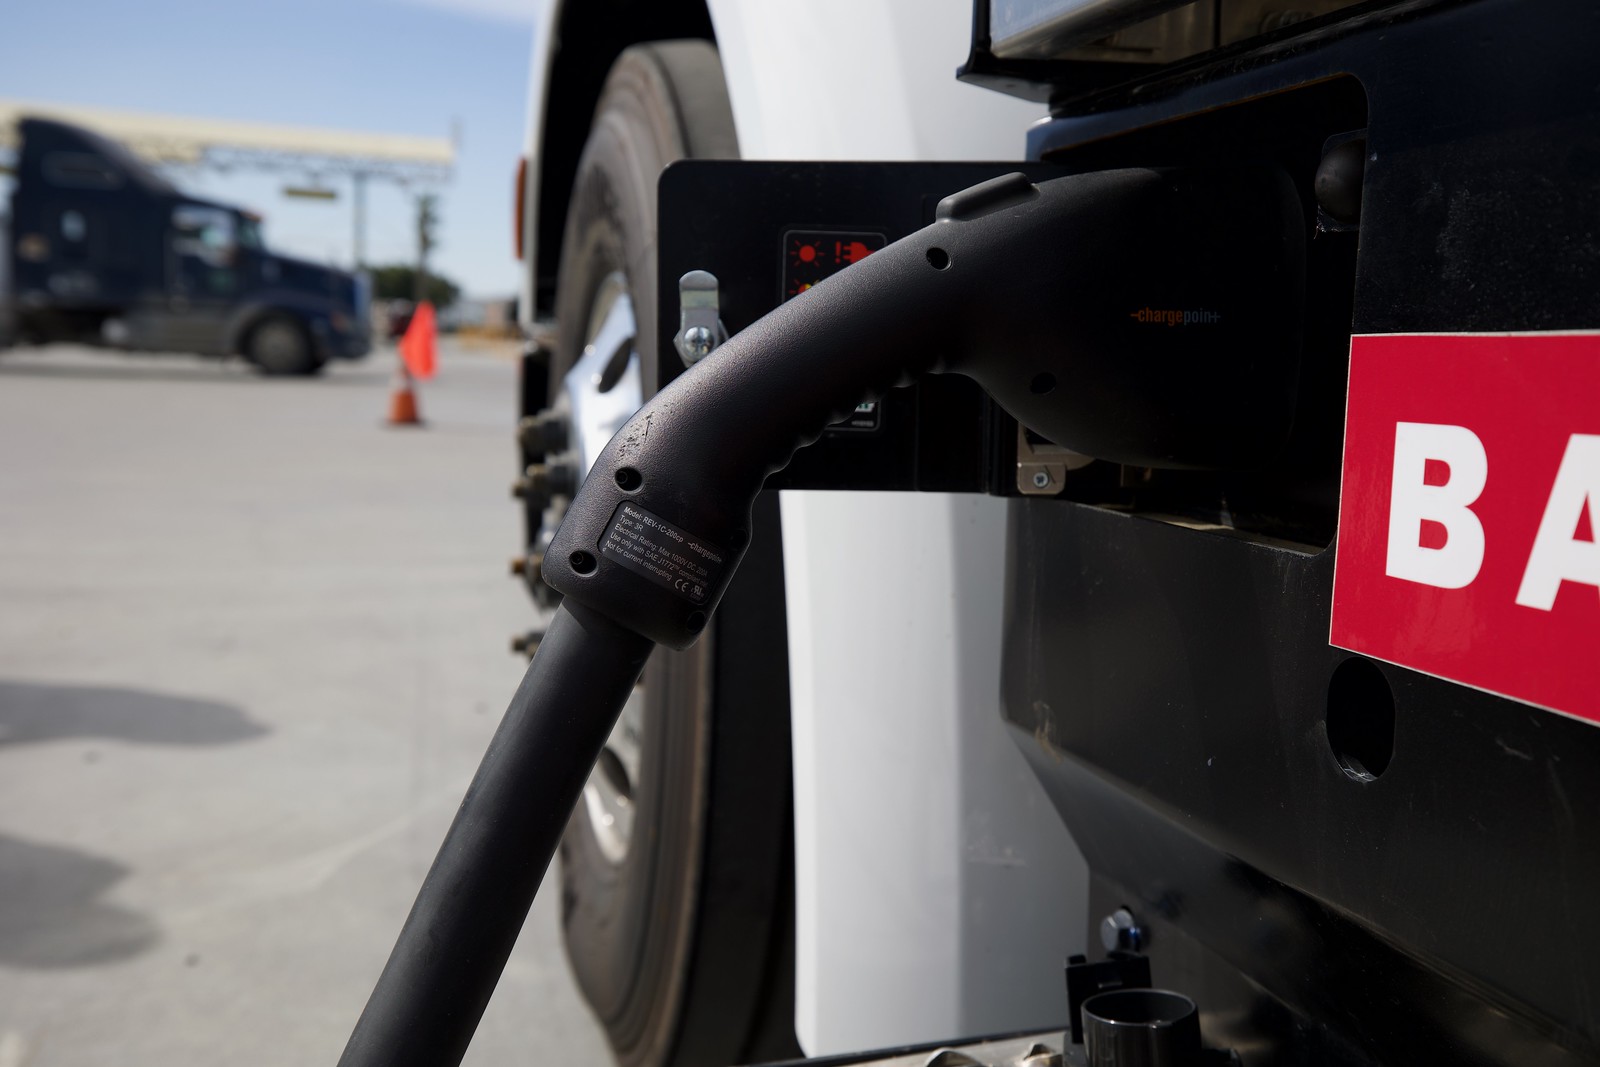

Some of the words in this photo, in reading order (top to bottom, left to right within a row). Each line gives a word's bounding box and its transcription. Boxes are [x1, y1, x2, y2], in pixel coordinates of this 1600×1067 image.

[614, 523, 639, 541] Electrical
[638, 535, 657, 552] Rating:
[658, 546, 671, 558] Max
[619, 514, 635, 527] Type:
[634, 522, 644, 532] 3R
[623, 506, 643, 521] Model:
[642, 516, 684, 543] REV-1C-200cp
[605, 540, 616, 550] Not
[615, 545, 624, 554] for
[623, 550, 644, 565] current
[642, 561, 673, 582] interrupting
[610, 532, 621, 542] Use
[621, 537, 633, 550] only
[633, 543, 645, 555] with
[644, 550, 659, 563] SAE
